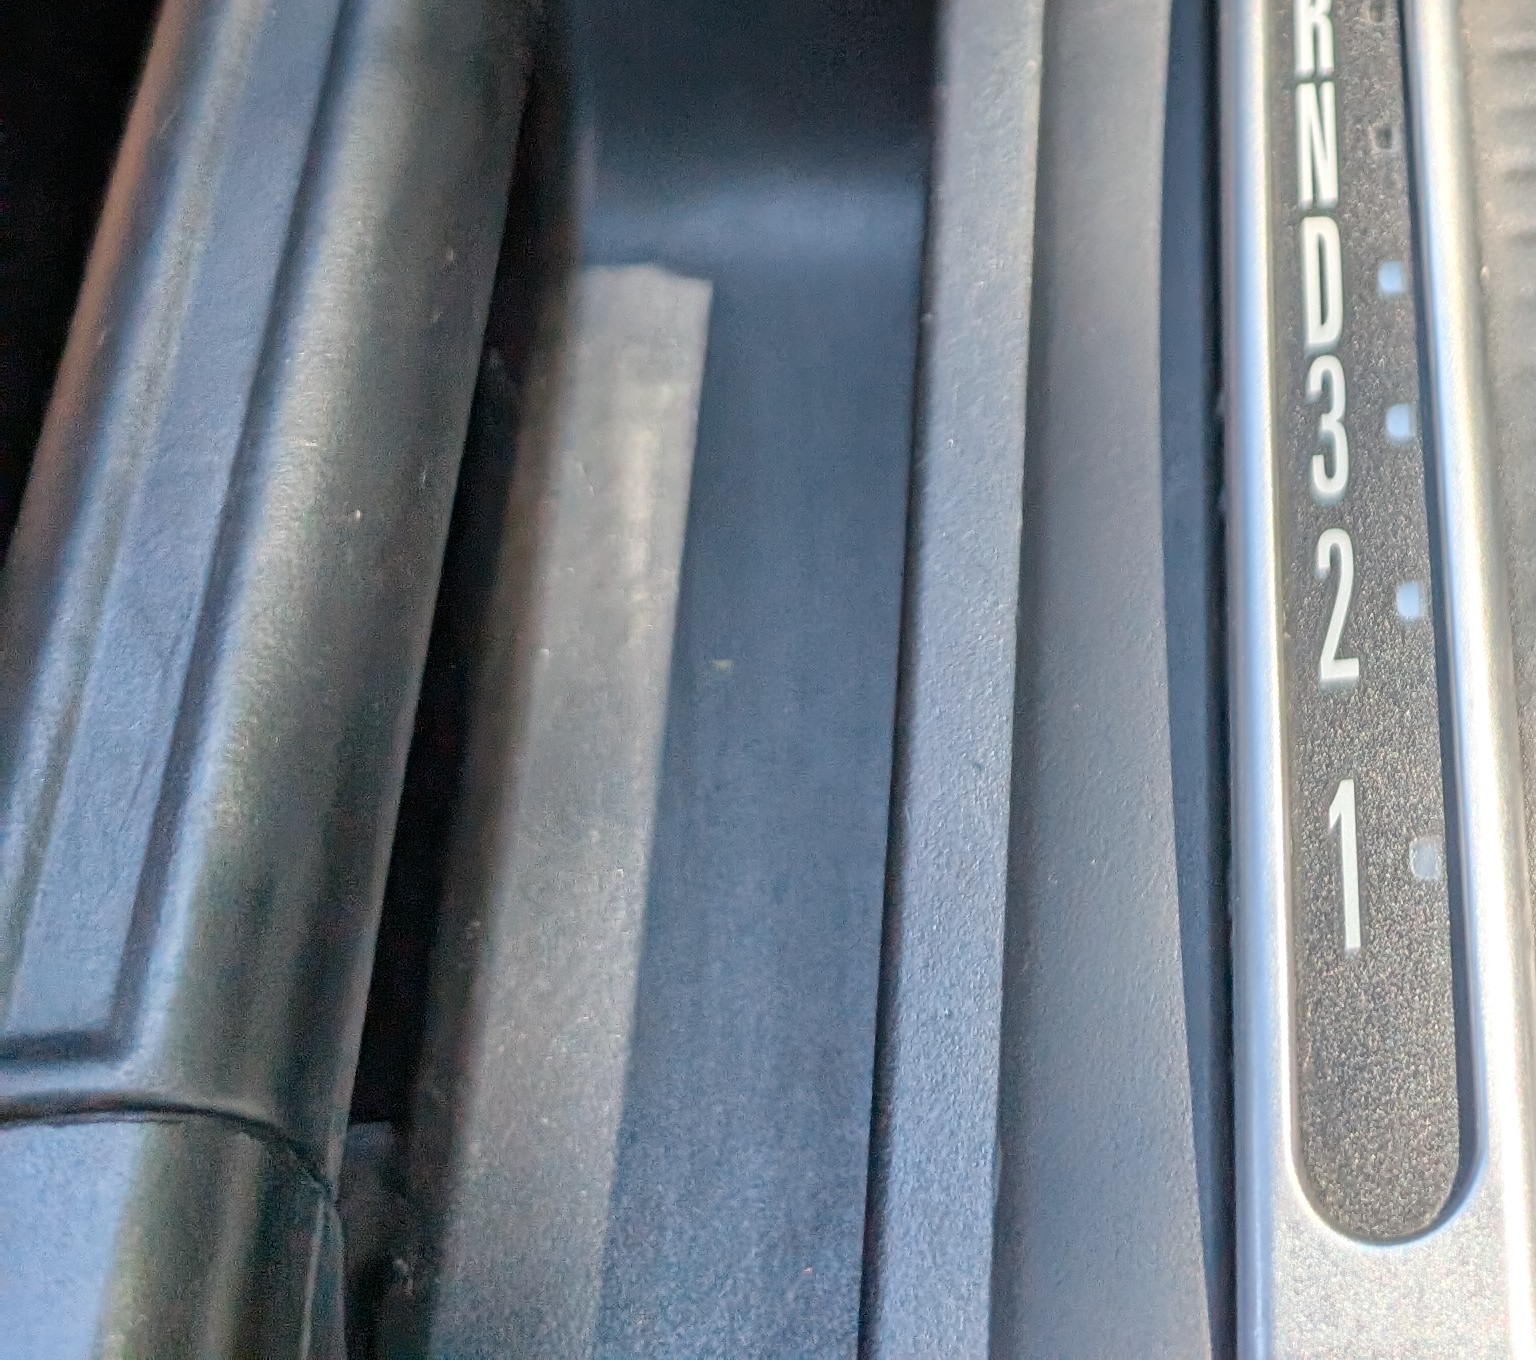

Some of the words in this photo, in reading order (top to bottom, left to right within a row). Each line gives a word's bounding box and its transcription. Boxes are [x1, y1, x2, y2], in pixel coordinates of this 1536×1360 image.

[1295, 81, 1339, 210] N
[1300, 216, 1344, 346] D
[1307, 354, 1350, 504] 3
[1315, 527, 1360, 685] 2
[1327, 778, 1361, 951] 1
